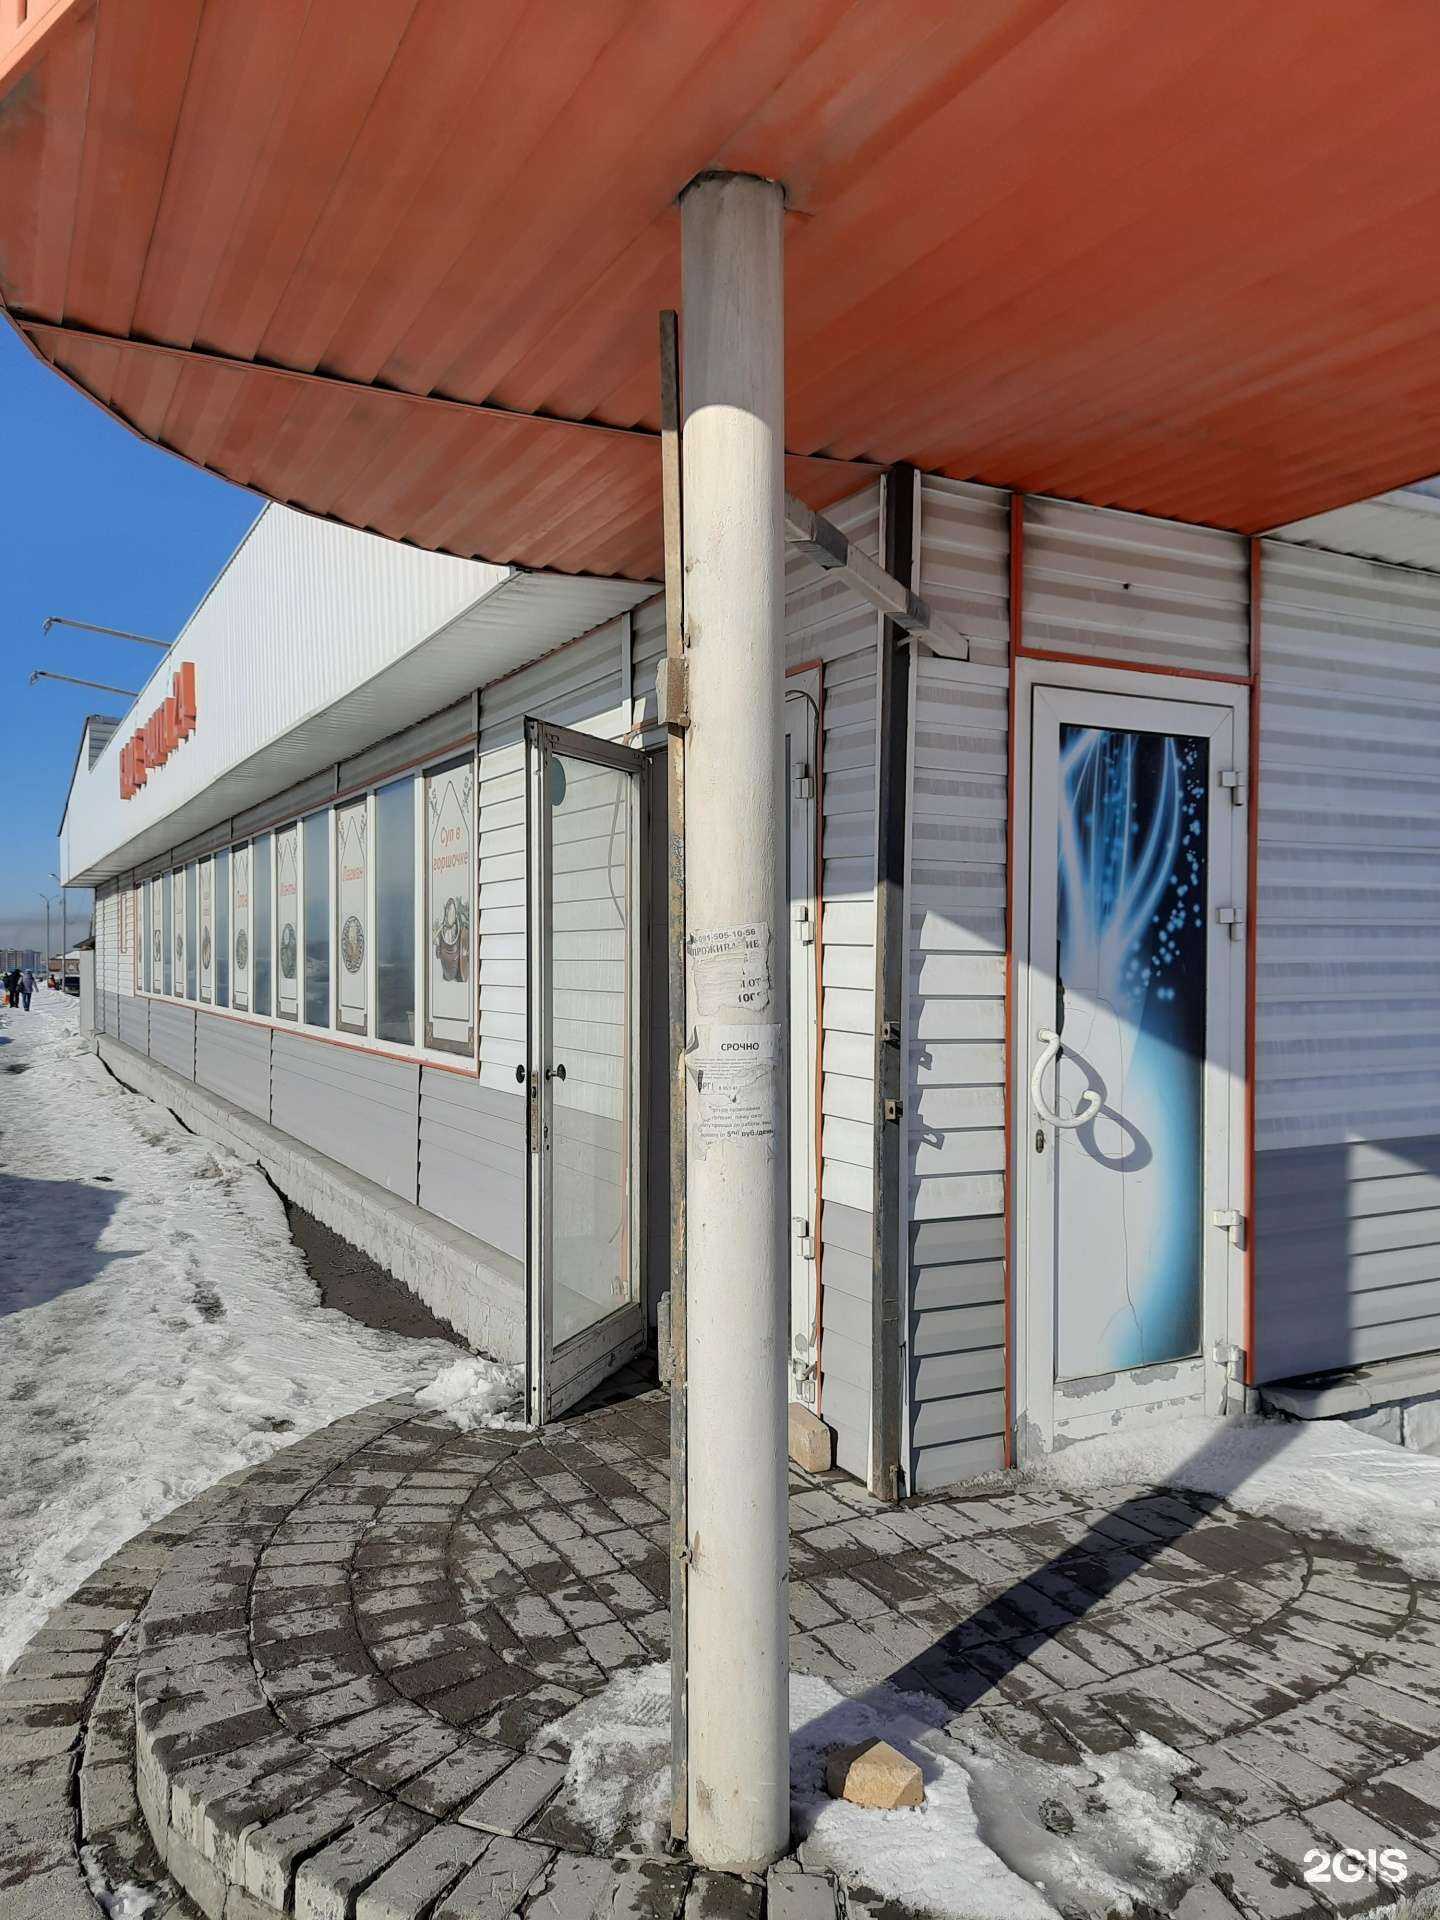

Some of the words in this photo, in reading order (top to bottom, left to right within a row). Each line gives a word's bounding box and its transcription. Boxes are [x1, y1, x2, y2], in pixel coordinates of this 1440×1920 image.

[440, 826, 454, 847] Суп
[692, 939, 760, 957] ПРОЖИВАИЕ
[720, 1042, 760, 1052] СРОЧНО
